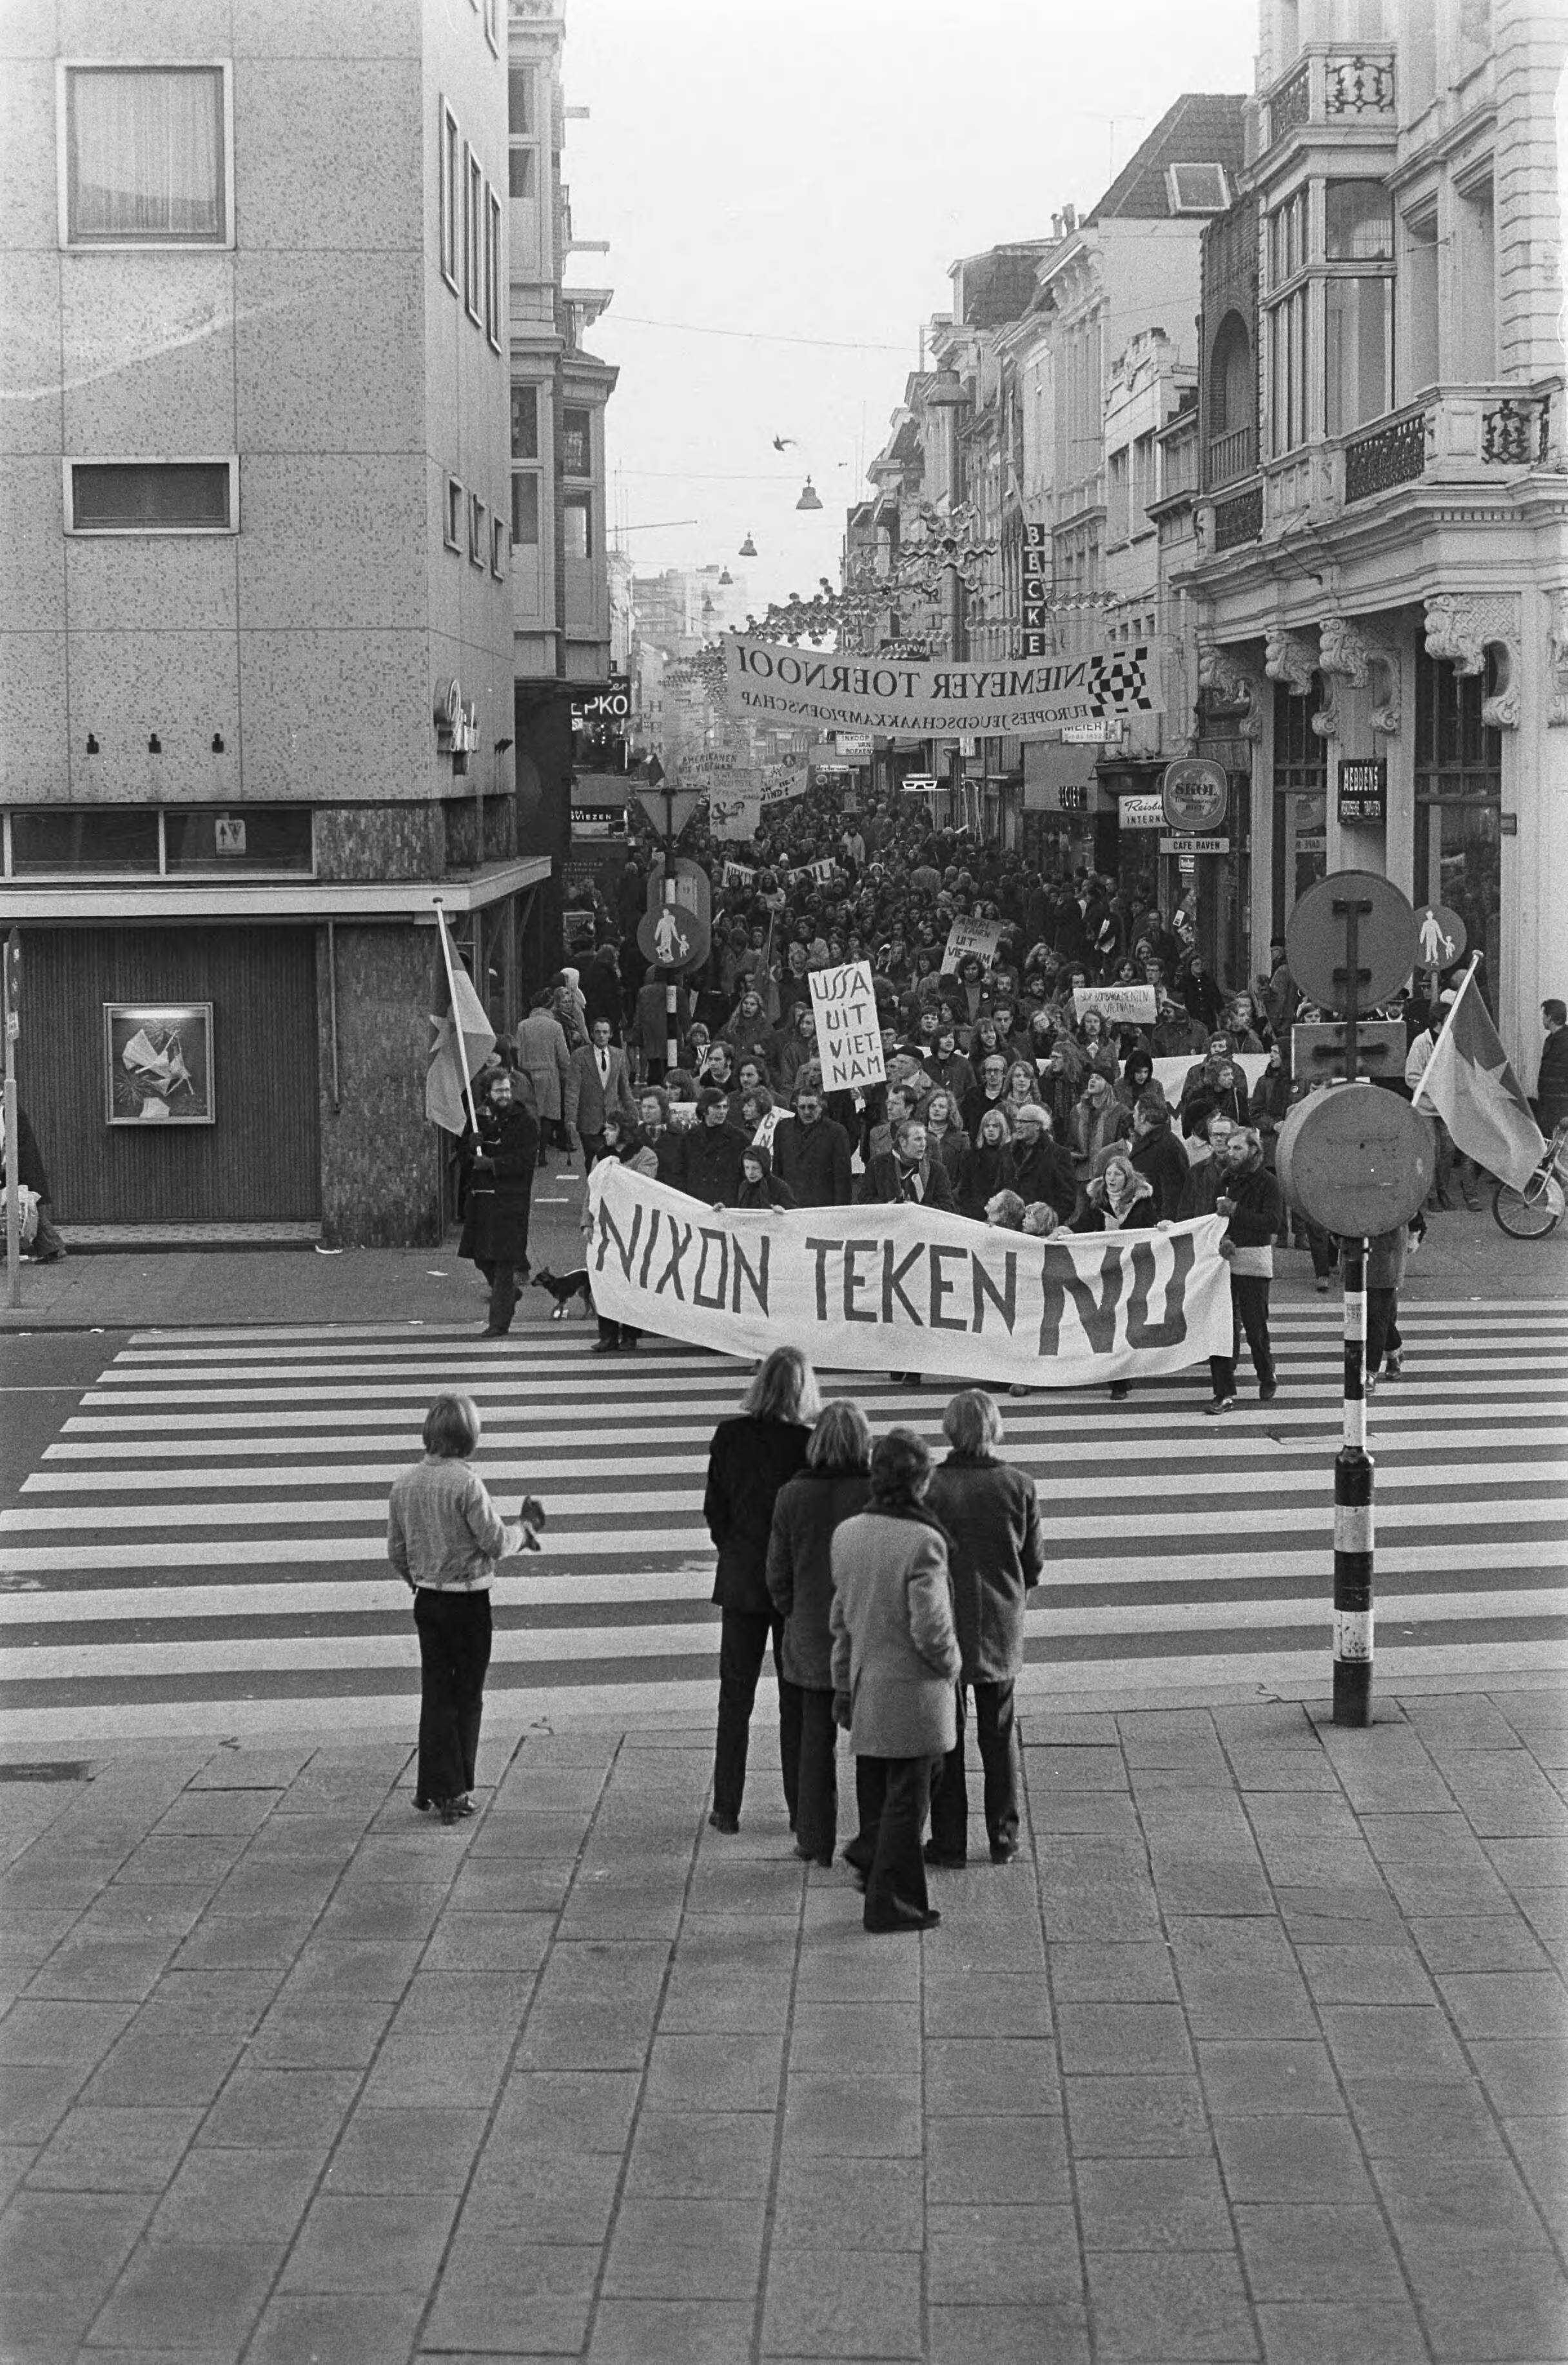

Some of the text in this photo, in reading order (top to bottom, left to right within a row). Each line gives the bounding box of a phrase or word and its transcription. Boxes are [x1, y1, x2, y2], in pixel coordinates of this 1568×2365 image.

[1175, 783, 1217, 796] SKOL
[1173, 841, 1220, 850] CAFE RAVEN
[956, 936, 977, 947] UIT
[832, 1055, 881, 1083] NAM
[596, 1196, 1195, 1357] NIXON TEKEN NU
